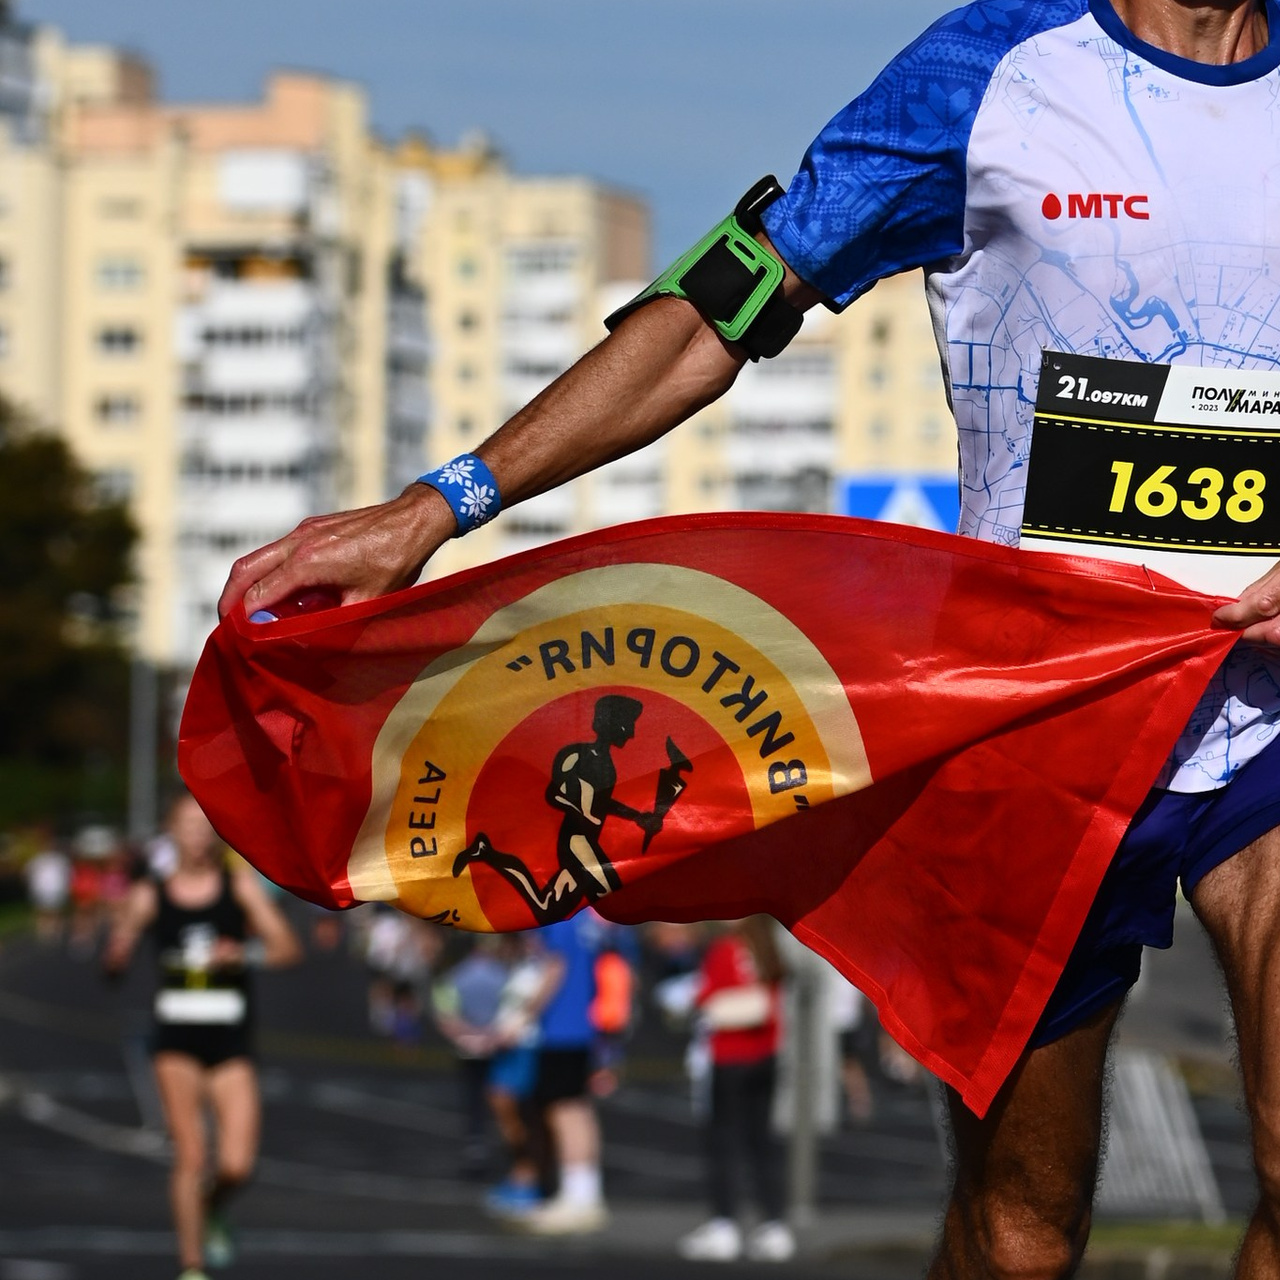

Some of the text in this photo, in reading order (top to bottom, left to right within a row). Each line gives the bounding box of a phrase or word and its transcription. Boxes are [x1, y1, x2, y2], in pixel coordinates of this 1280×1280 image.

[1068, 194, 1149, 220] МТС
[1192, 386, 1246, 407] ПОЛУ
[1198, 403, 1219, 412] 2023
[1108, 460, 1267, 524] 1638
